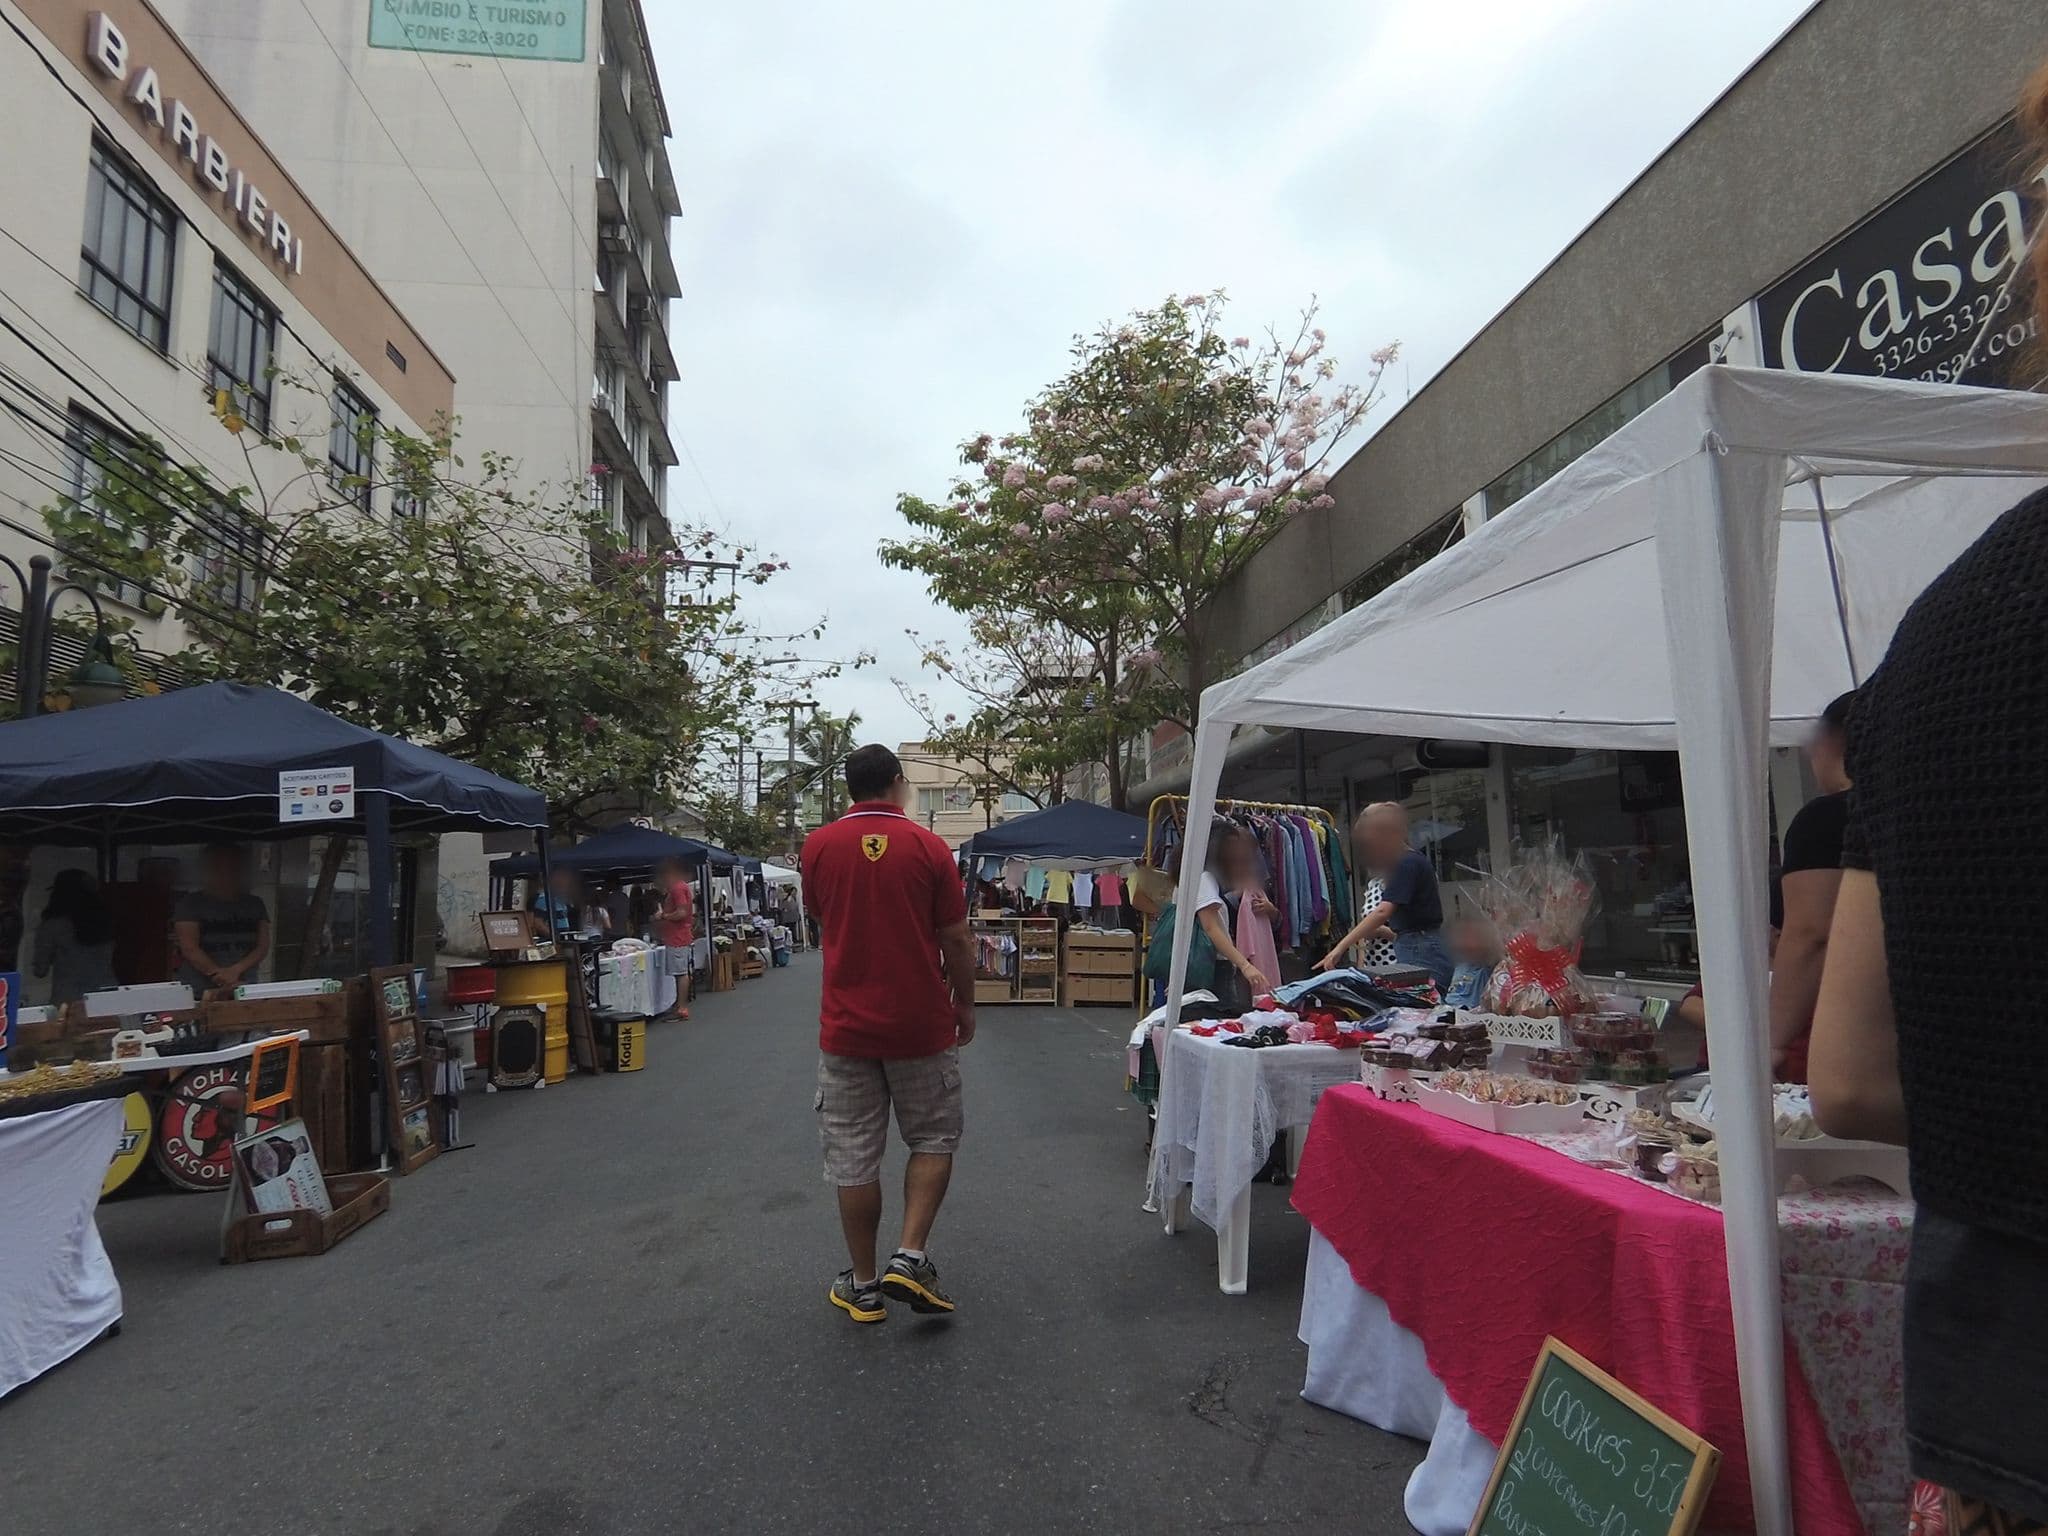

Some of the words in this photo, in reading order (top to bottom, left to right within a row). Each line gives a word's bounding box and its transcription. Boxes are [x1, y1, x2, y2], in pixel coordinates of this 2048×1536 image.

[469, 8, 478, 21] E
[485, 6, 567, 27] TURISMO
[90, 11, 303, 276] BARBIERI
[1781, 165, 2048, 374] Casa
[619, 1026, 633, 1068] Kodak
[166, 1137, 230, 1179] GASOL
